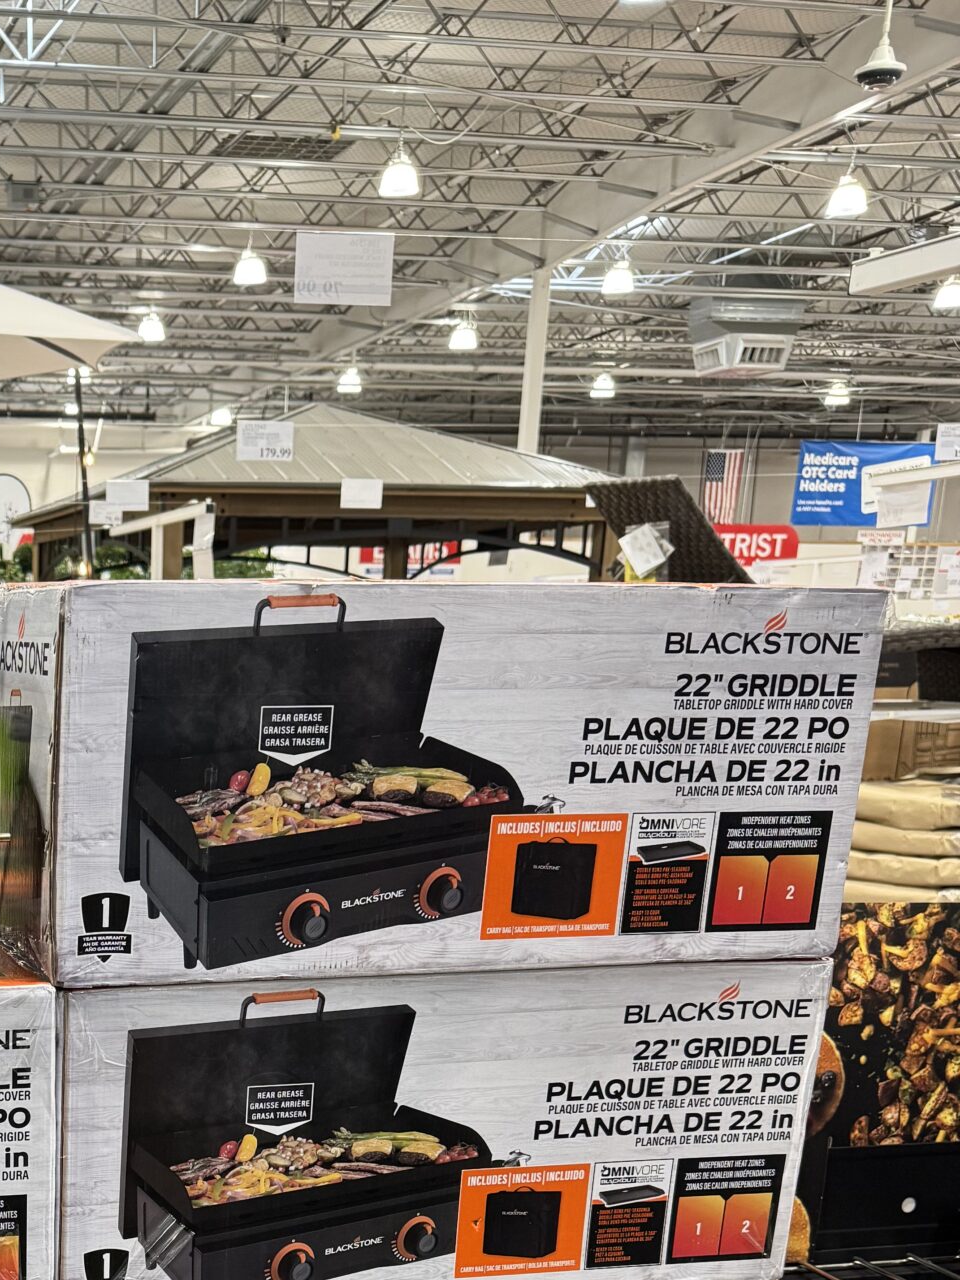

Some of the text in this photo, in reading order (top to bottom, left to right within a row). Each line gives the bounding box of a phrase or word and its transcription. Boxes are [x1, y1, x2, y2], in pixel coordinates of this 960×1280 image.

[260, 447, 292, 459] 179.99
[803, 452, 859, 466] Medicare
[801, 466, 857, 479] OTC Card
[799, 479, 847, 493] Holders
[674, 673, 857, 697] 22" GRIDDLE
[672, 698, 853, 710] TABLETOP GRIDDLE WITH HARD COVER
[271, 713, 323, 722] REAR GREASE
[262, 723, 329, 734] GRAISSE ARRIÈRE
[582, 716, 849, 743] PLAQUE DE 22 PO
[264, 737, 326, 746] GRASA TRASERA
[568, 759, 841, 784] PLANCHA DE 22 in
[633, 1034, 808, 1061] 22" GRIDDLE
[546, 1072, 801, 1103] PLAQUE DE 22 PO
[533, 1109, 793, 1140] PLANCHA DE 22 in
[5, 1147, 29, 1168] in
